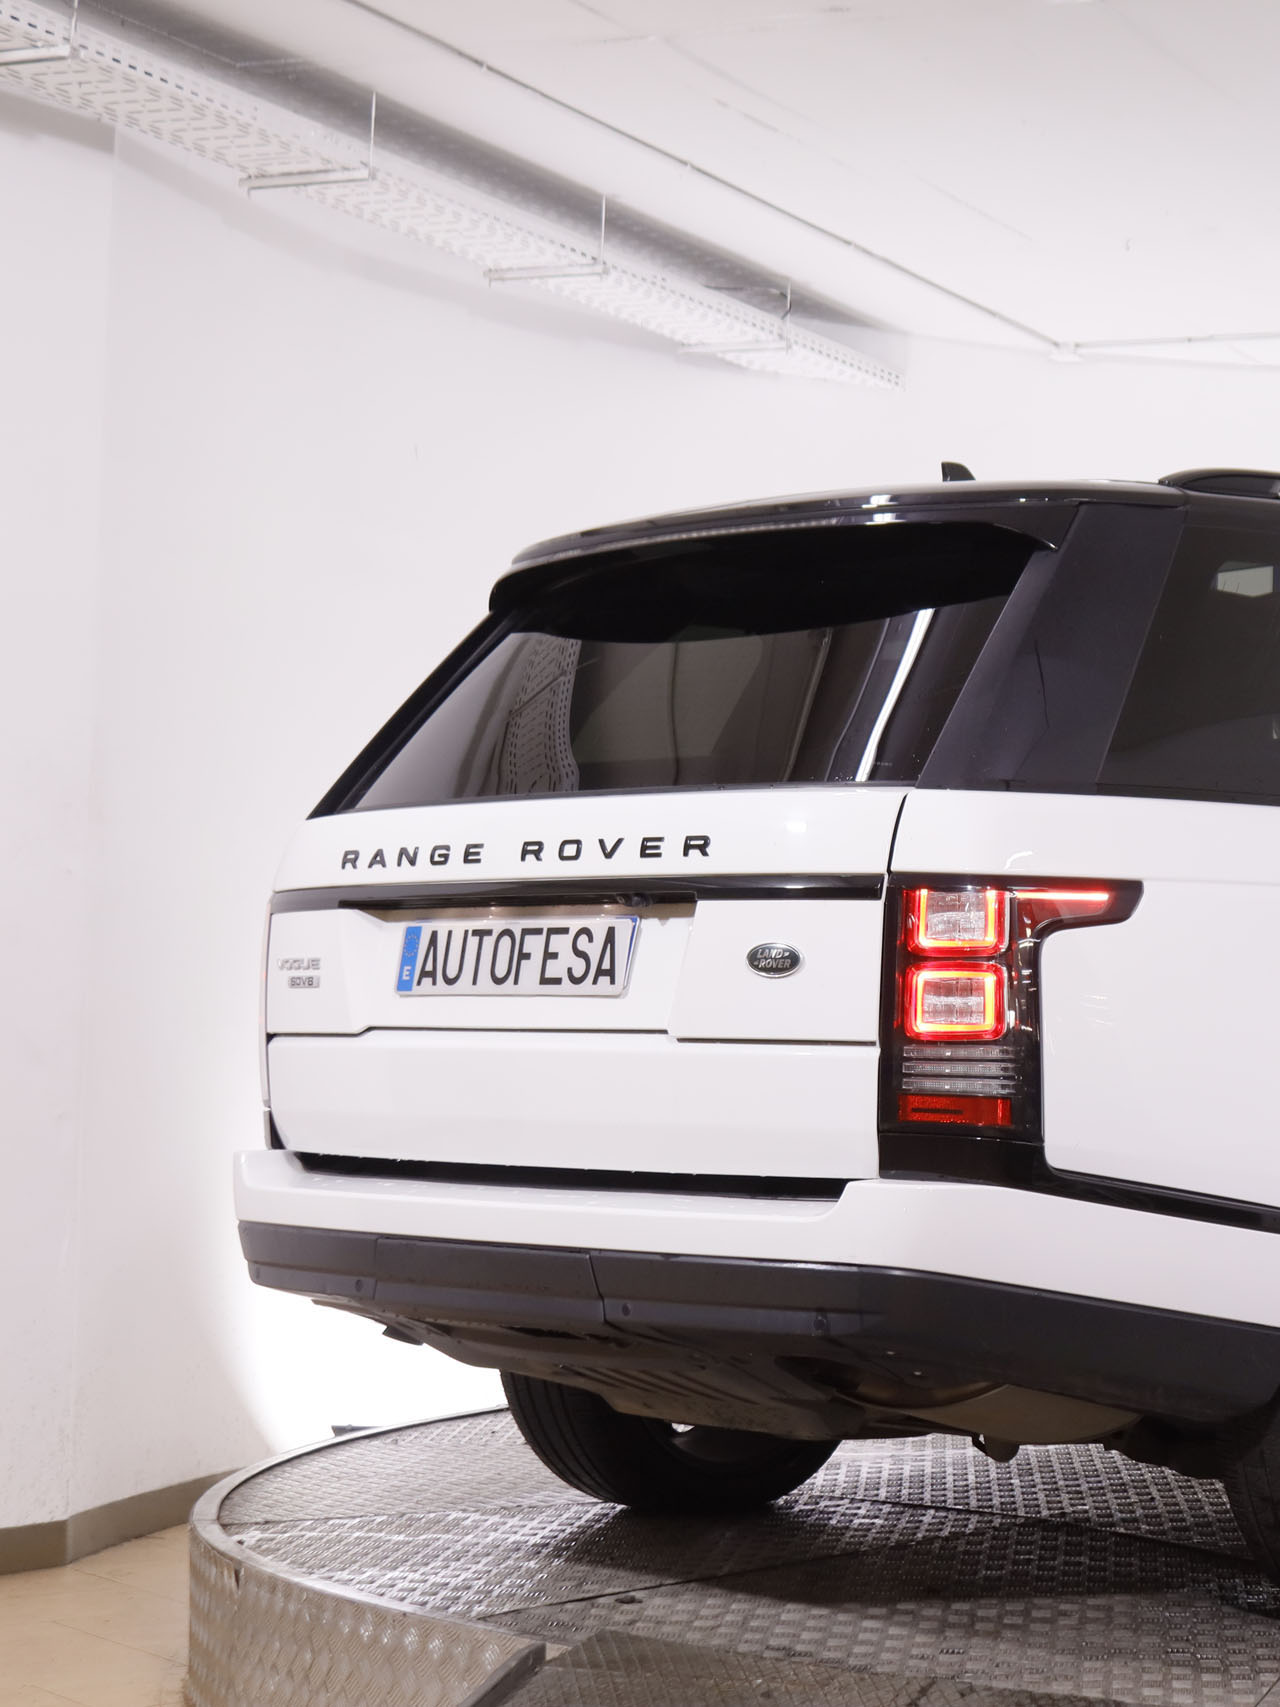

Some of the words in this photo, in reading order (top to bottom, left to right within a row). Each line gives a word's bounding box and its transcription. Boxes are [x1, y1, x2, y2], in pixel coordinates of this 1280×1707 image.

[341, 842, 485, 870] RANGE
[520, 834, 711, 862] ROVER
[416, 926, 616, 986] AUTOFESA
[757, 948, 784, 959] LAND
[758, 958, 792, 969] ROVER
[402, 966, 412, 980] E
